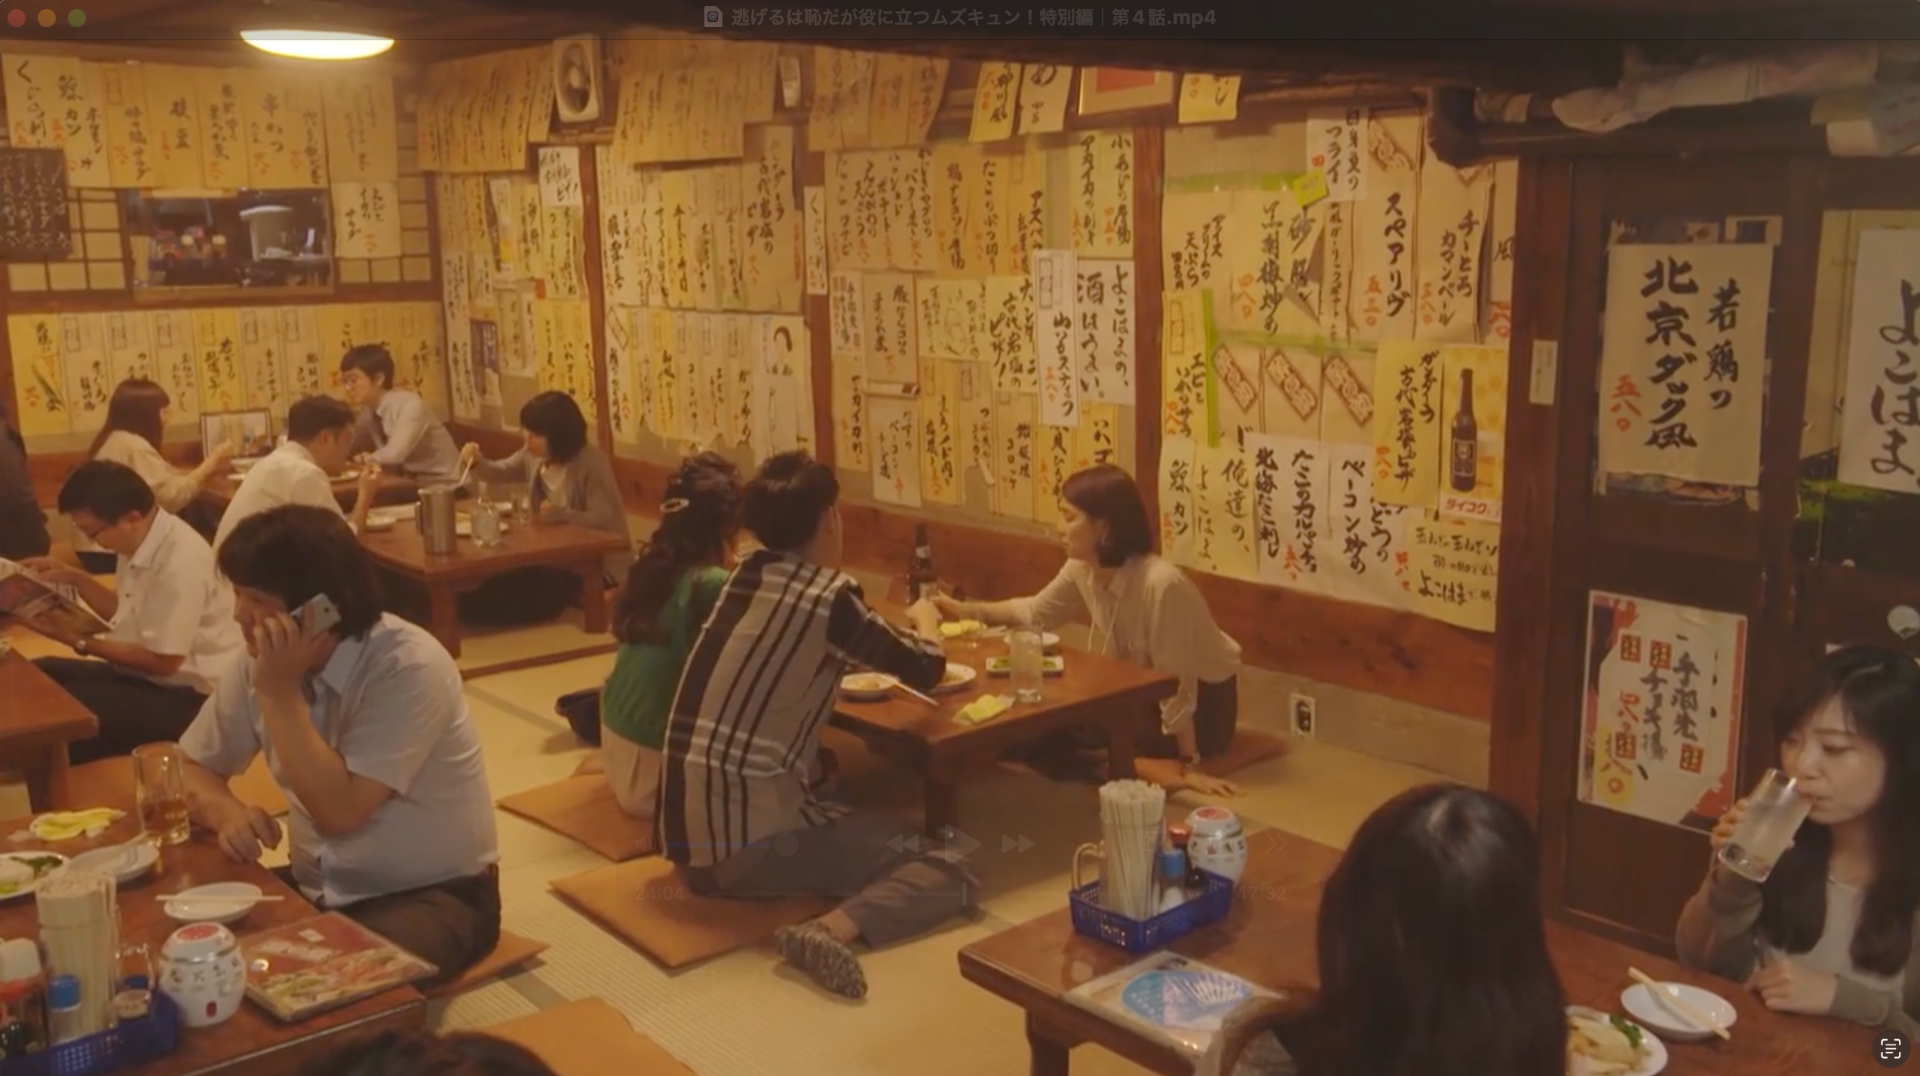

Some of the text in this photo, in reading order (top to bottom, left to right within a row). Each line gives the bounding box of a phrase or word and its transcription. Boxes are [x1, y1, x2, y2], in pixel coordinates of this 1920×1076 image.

[1346, 106, 1362, 191] 白身魚の
[876, 175, 892, 234] ポテト
[1211, 213, 1227, 259] アイス
[1184, 230, 1200, 289] 天ぷら
[1438, 228, 1457, 327] カマンベール
[1191, 351, 1206, 404] エビと
[1640, 254, 1700, 450] 北京ダック風
[1704, 277, 1741, 410] 若鶏の
[1610, 373, 1642, 433] 五八〇
[1341, 459, 1368, 576] ベーコン炒め
